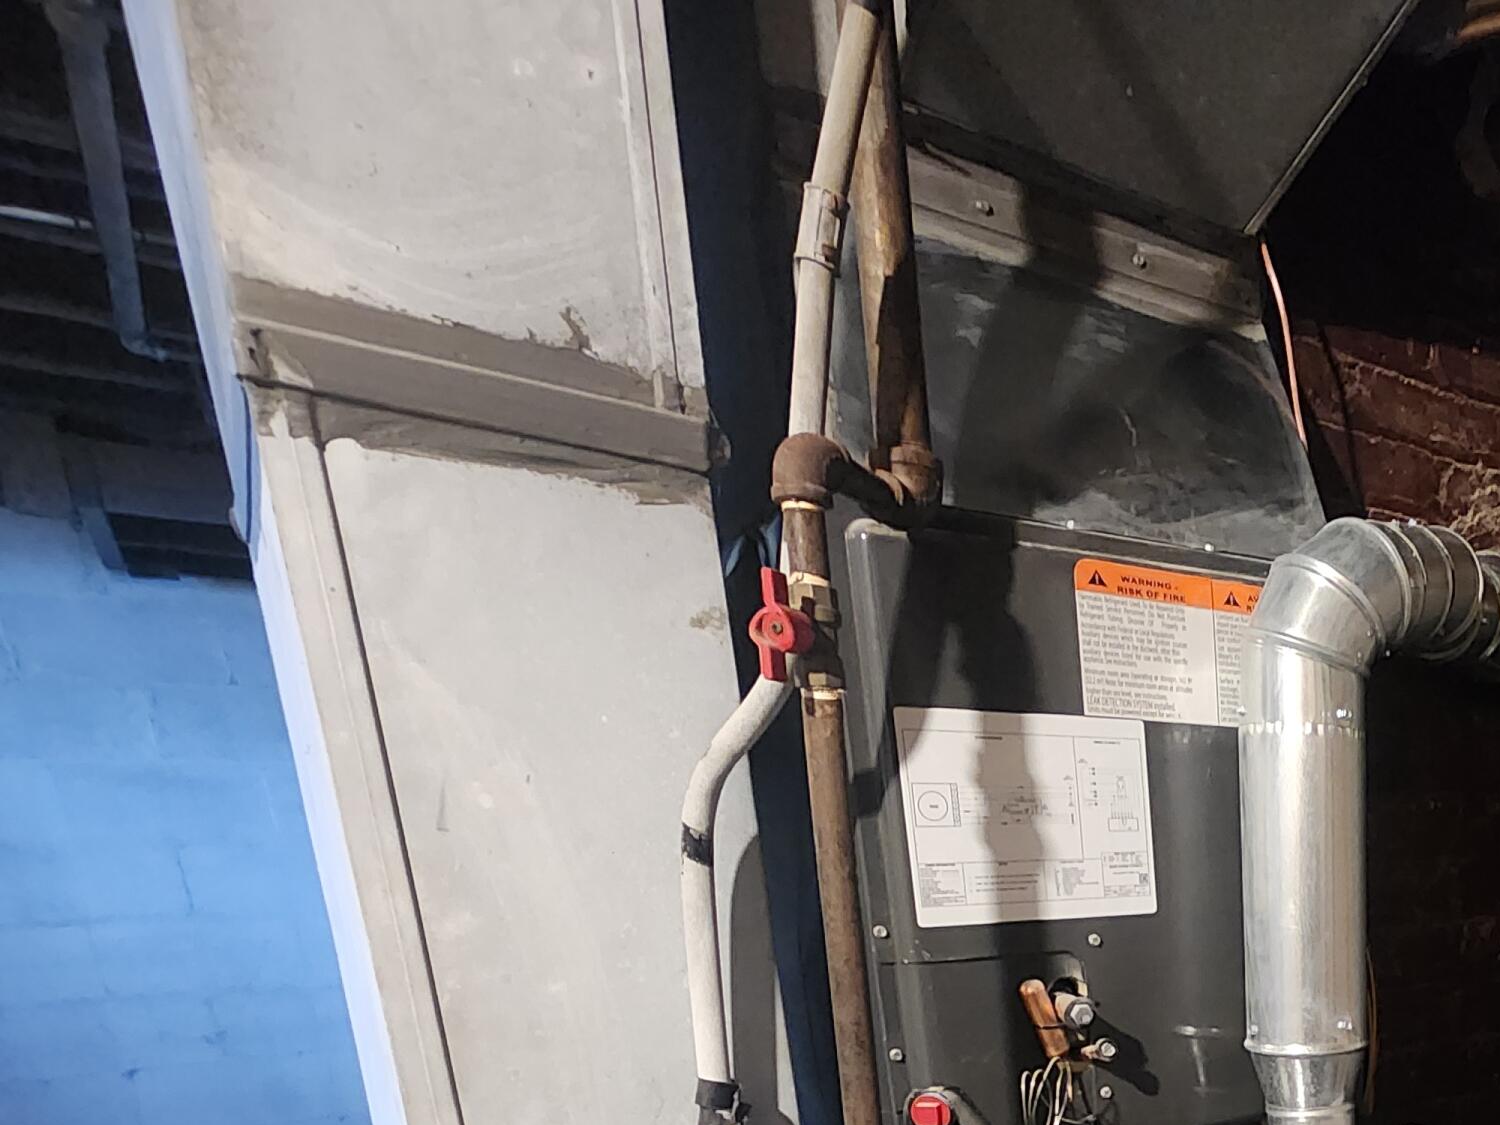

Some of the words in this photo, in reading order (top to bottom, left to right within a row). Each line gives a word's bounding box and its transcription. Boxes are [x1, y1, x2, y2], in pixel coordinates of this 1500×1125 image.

[1121, 575, 1172, 589] WARNING
[1117, 586, 1142, 598] RISK
[1146, 590, 1159, 600] OF
[1163, 593, 1186, 603] FIRE
